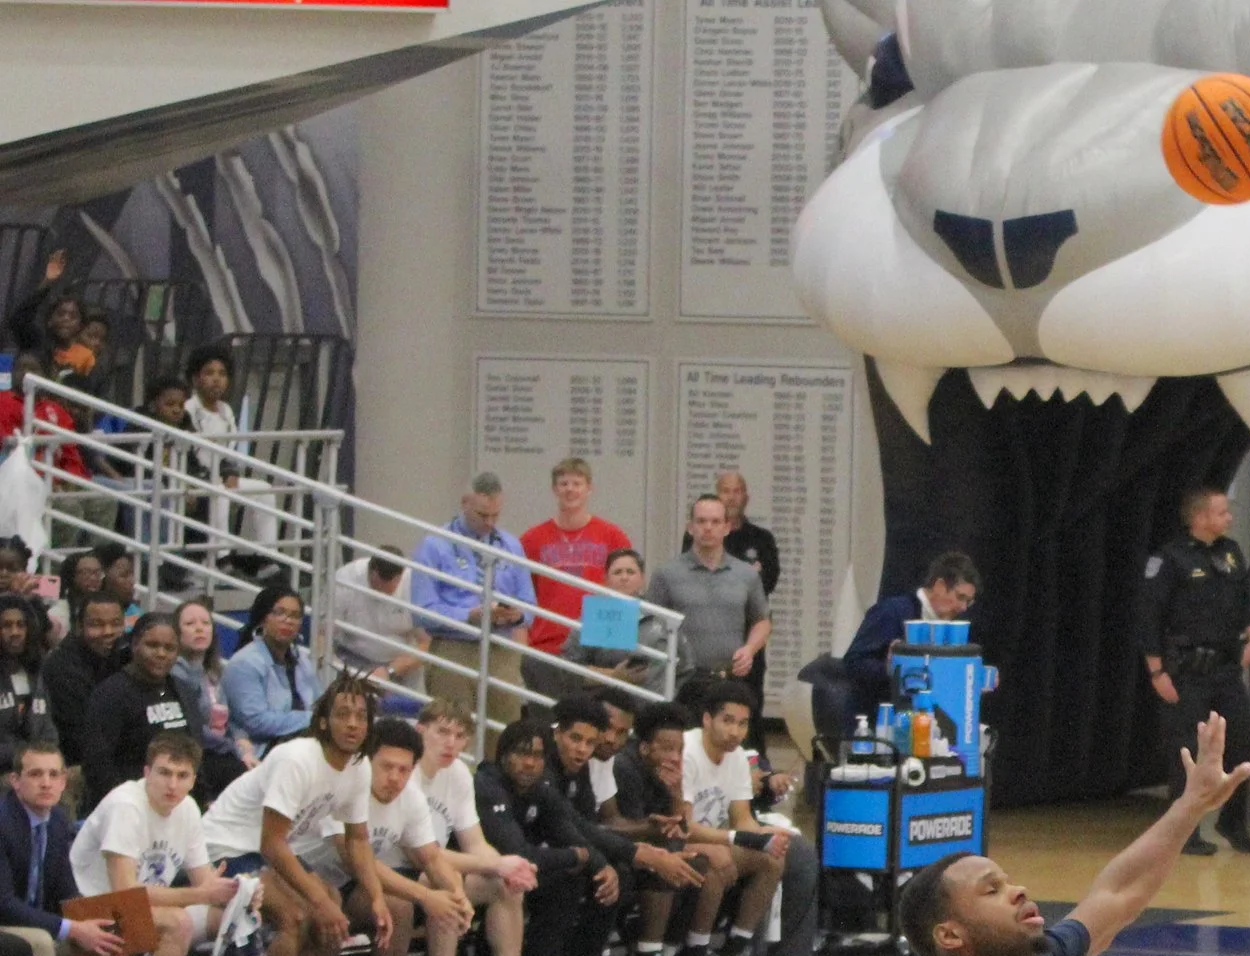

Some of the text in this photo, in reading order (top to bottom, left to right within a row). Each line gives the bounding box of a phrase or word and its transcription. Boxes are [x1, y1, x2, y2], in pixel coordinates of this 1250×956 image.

[686, 371, 846, 389] All Time Leading Rebounders
[826, 821, 883, 836] POWERADE
[909, 814, 973, 842] POWERADE
